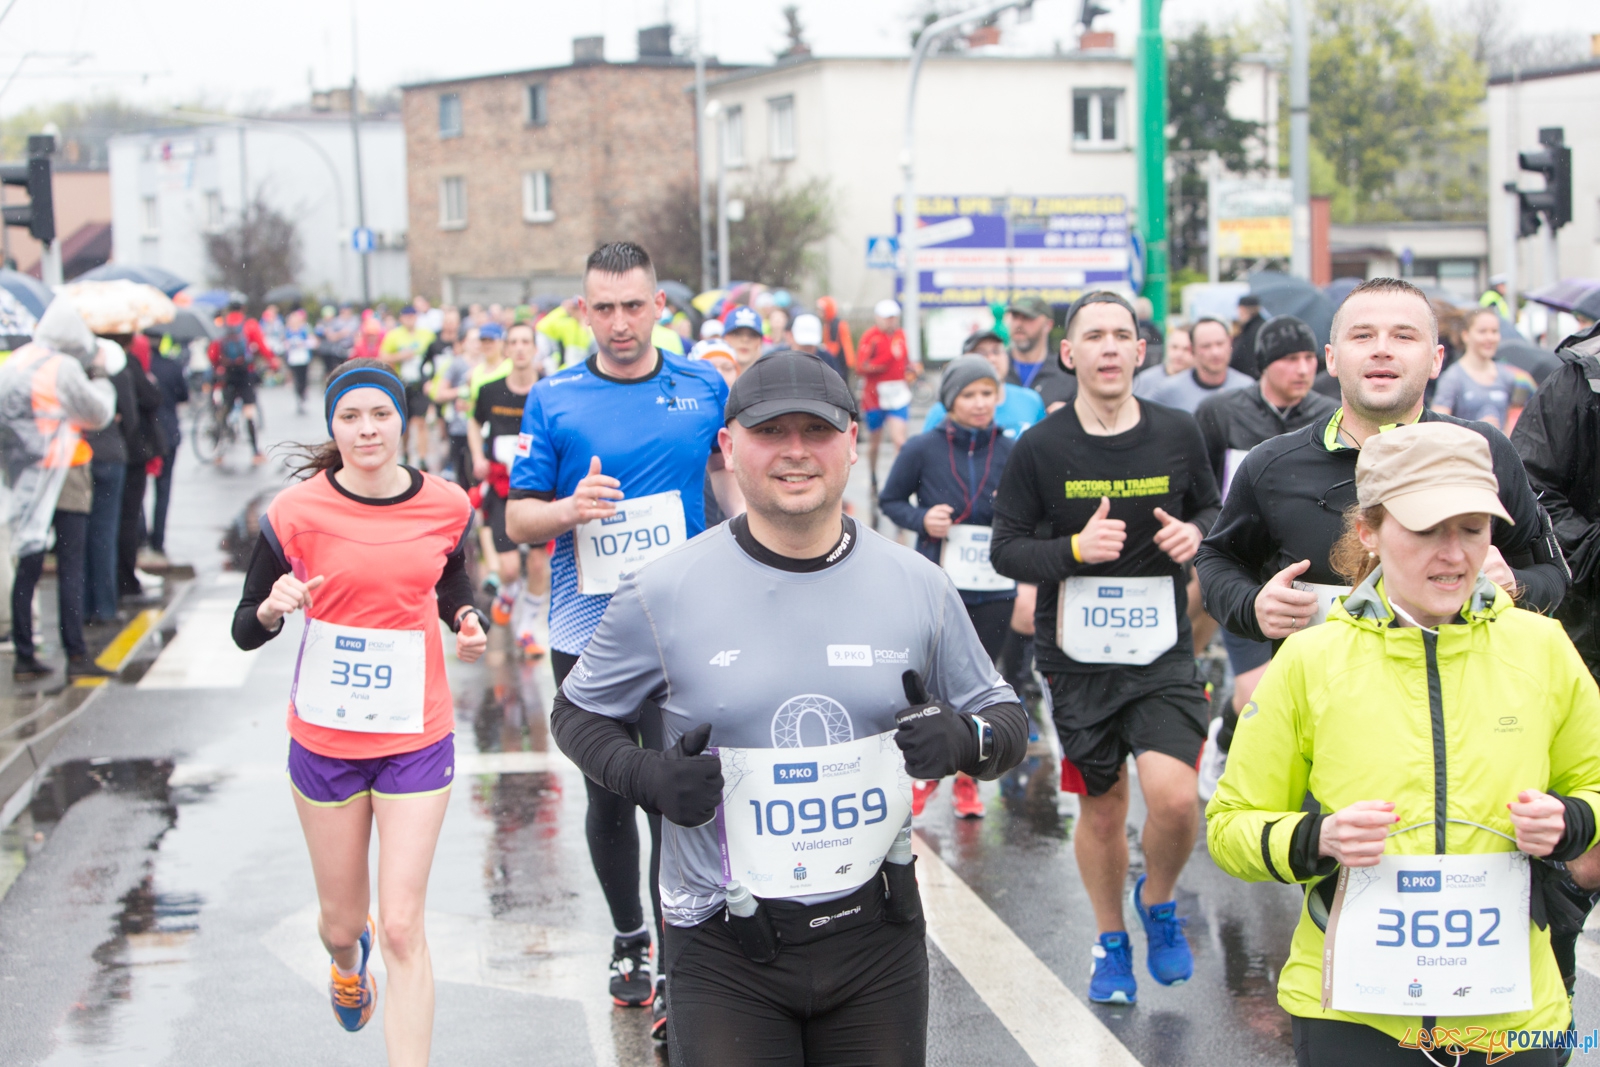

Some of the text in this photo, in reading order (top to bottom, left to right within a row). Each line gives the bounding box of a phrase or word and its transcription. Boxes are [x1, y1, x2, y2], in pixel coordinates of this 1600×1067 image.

[1065, 475, 1170, 491] DOCTORS IN TRAINING
[590, 524, 671, 557] 10790
[829, 532, 851, 562] KIPSTA
[1082, 606, 1159, 628] 10583
[709, 650, 741, 667] 4F
[330, 660, 392, 690] 359
[350, 691, 370, 701] Ania
[749, 787, 888, 836] 10969
[792, 837, 854, 852] Waldemar
[835, 863, 853, 875] 4F
[1376, 907, 1501, 948] 3692
[1417, 955, 1468, 967] Barbara
[1452, 986, 1472, 998] 4F
